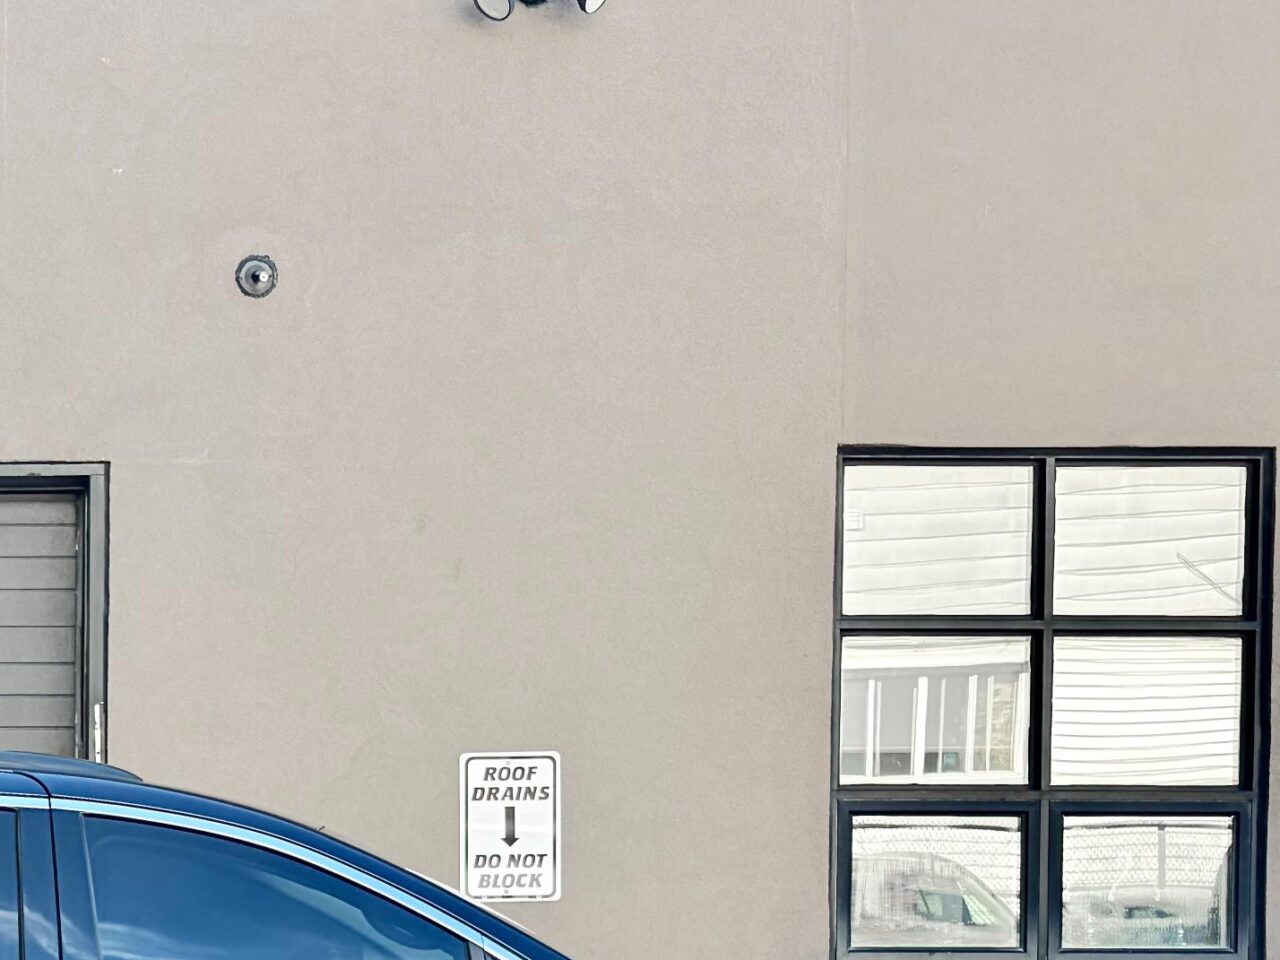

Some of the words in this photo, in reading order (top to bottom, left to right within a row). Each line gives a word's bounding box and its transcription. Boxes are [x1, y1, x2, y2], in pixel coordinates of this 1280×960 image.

[483, 766, 538, 781] ROOF
[471, 786, 550, 801] DRAINS
[473, 854, 501, 868] DO
[506, 853, 548, 868] NOT
[477, 873, 544, 888] BLOCK
